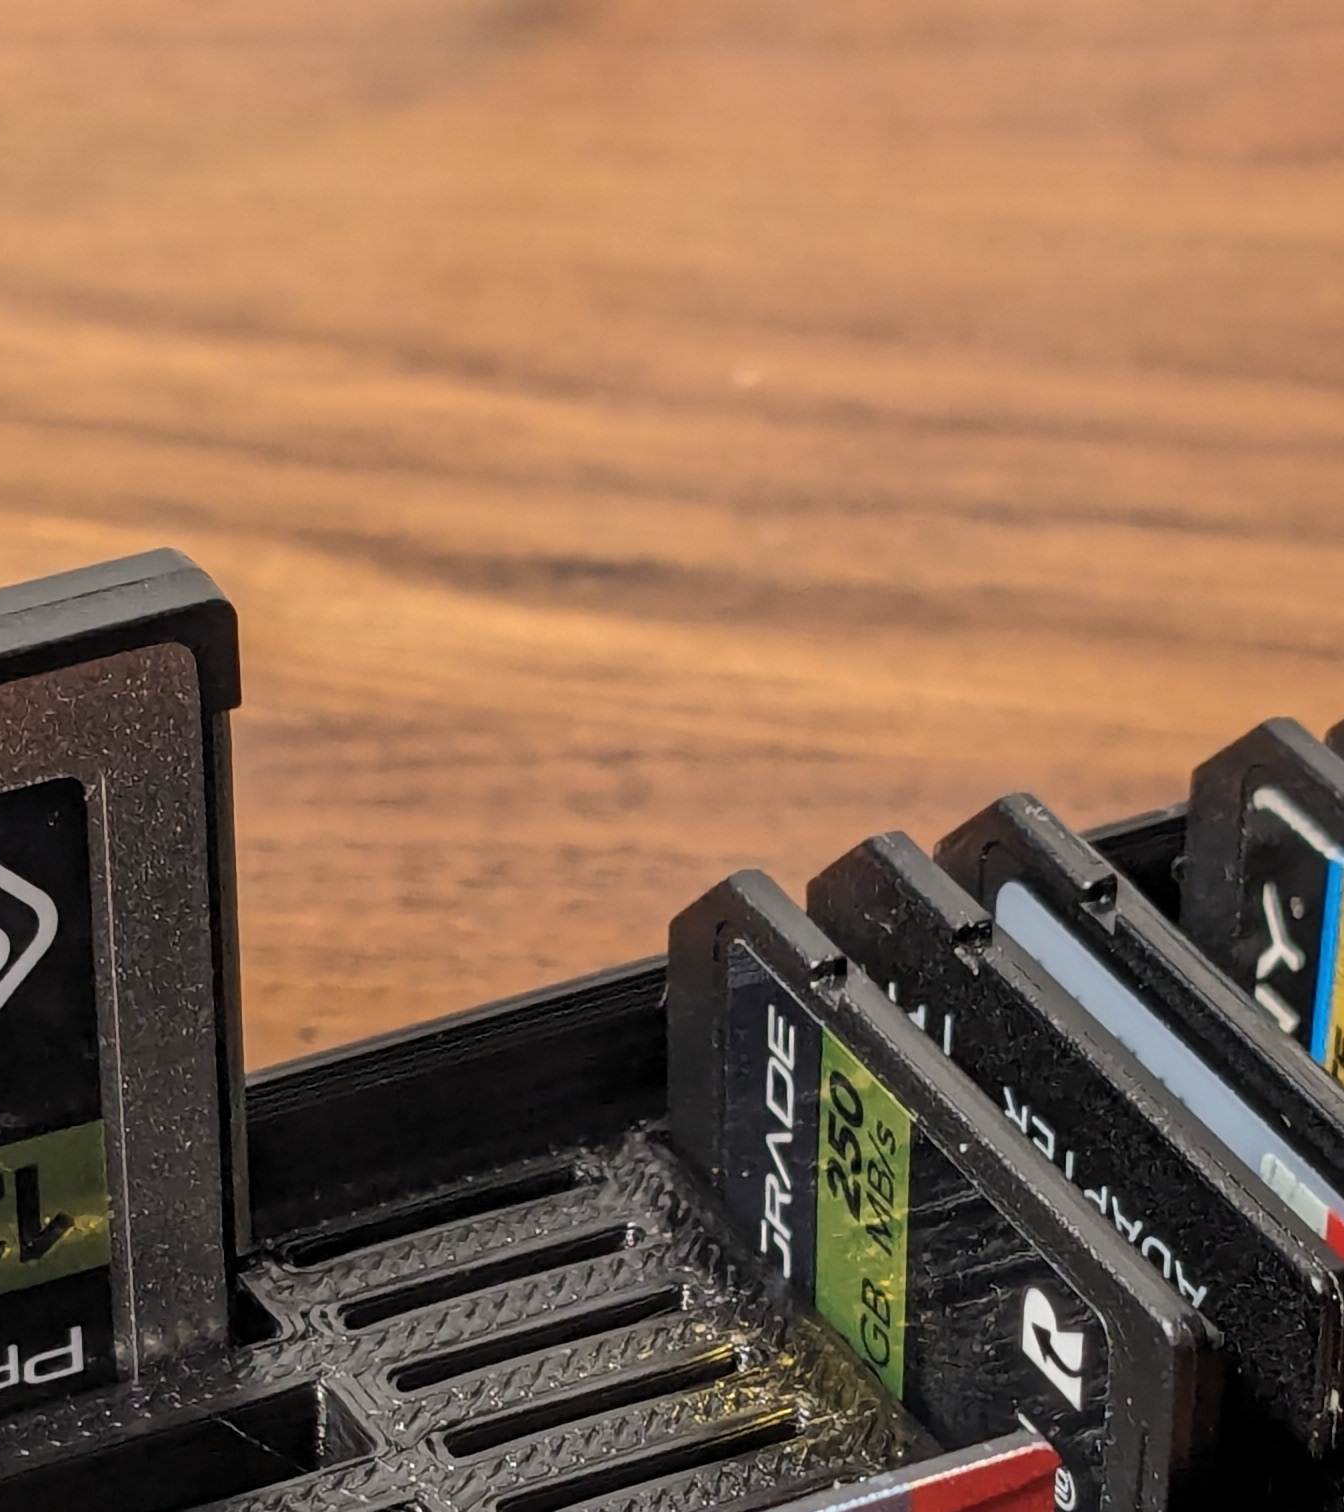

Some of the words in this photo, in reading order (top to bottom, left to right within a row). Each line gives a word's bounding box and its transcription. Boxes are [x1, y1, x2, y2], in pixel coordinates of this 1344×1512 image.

[826, 1070, 865, 1224] 250
[866, 1118, 898, 1257] MB/s
[860, 1277, 891, 1383] GB
